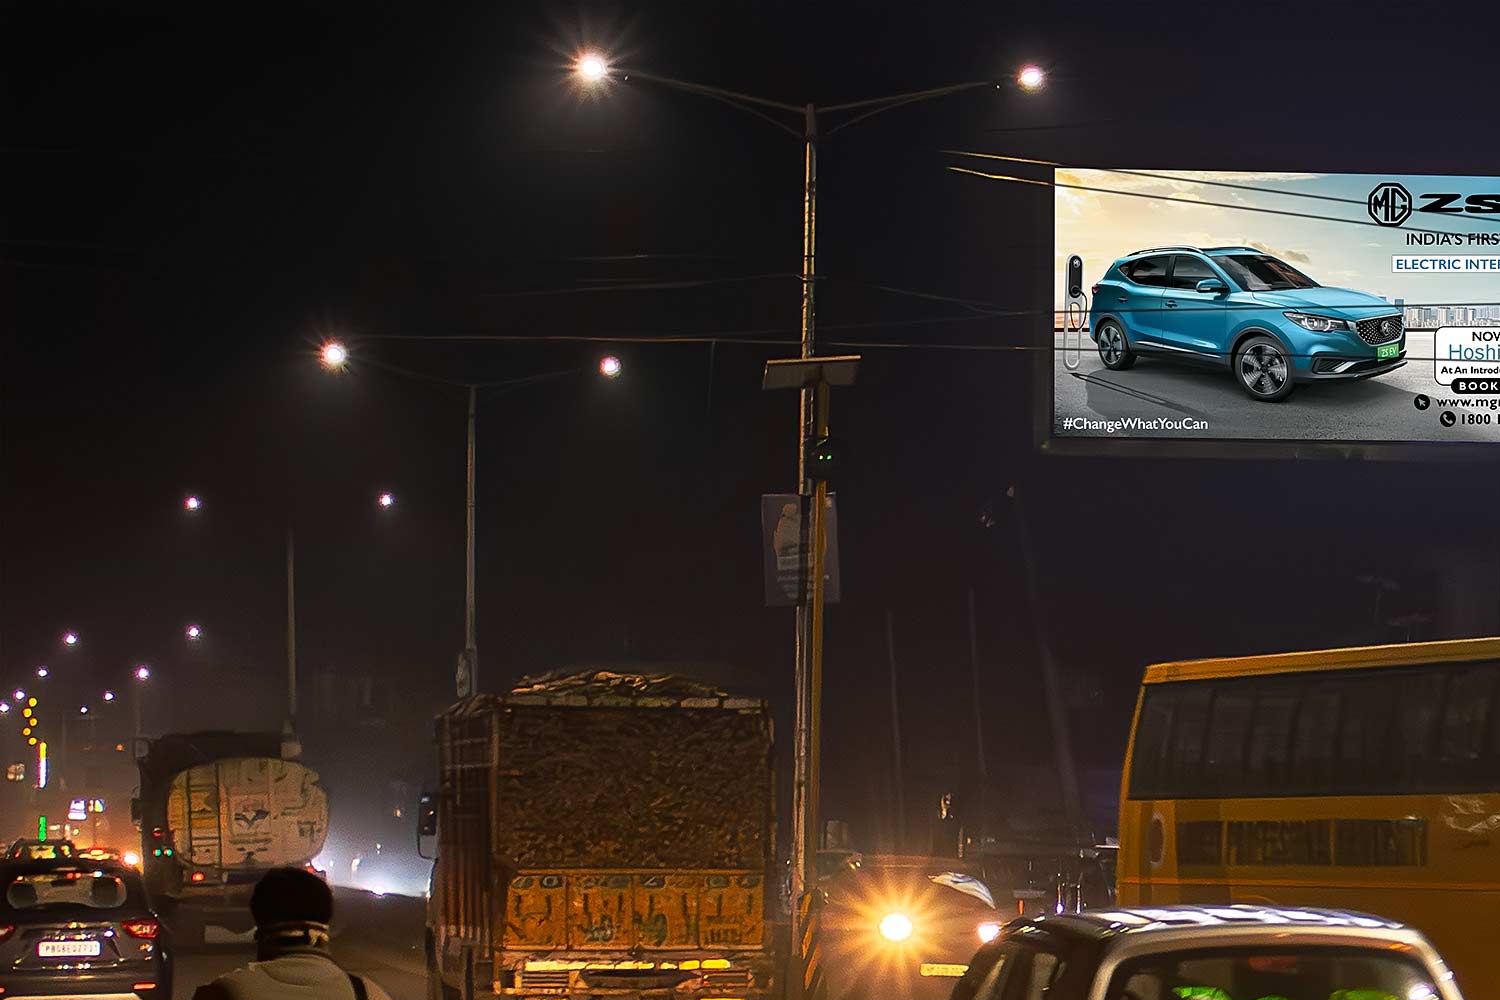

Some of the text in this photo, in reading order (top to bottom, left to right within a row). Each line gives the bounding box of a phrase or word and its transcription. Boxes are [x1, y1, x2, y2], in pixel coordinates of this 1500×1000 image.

[1371, 185, 1410, 224] MG
[1396, 259, 1461, 270] ELECTRIC
[1441, 366, 1452, 375] At
[1455, 366, 1468, 375] An
[1459, 381, 1499, 391] BOOK
[1461, 413, 1491, 425] 1800
[1063, 417, 1209, 433] #ChangeWhatYouCan
